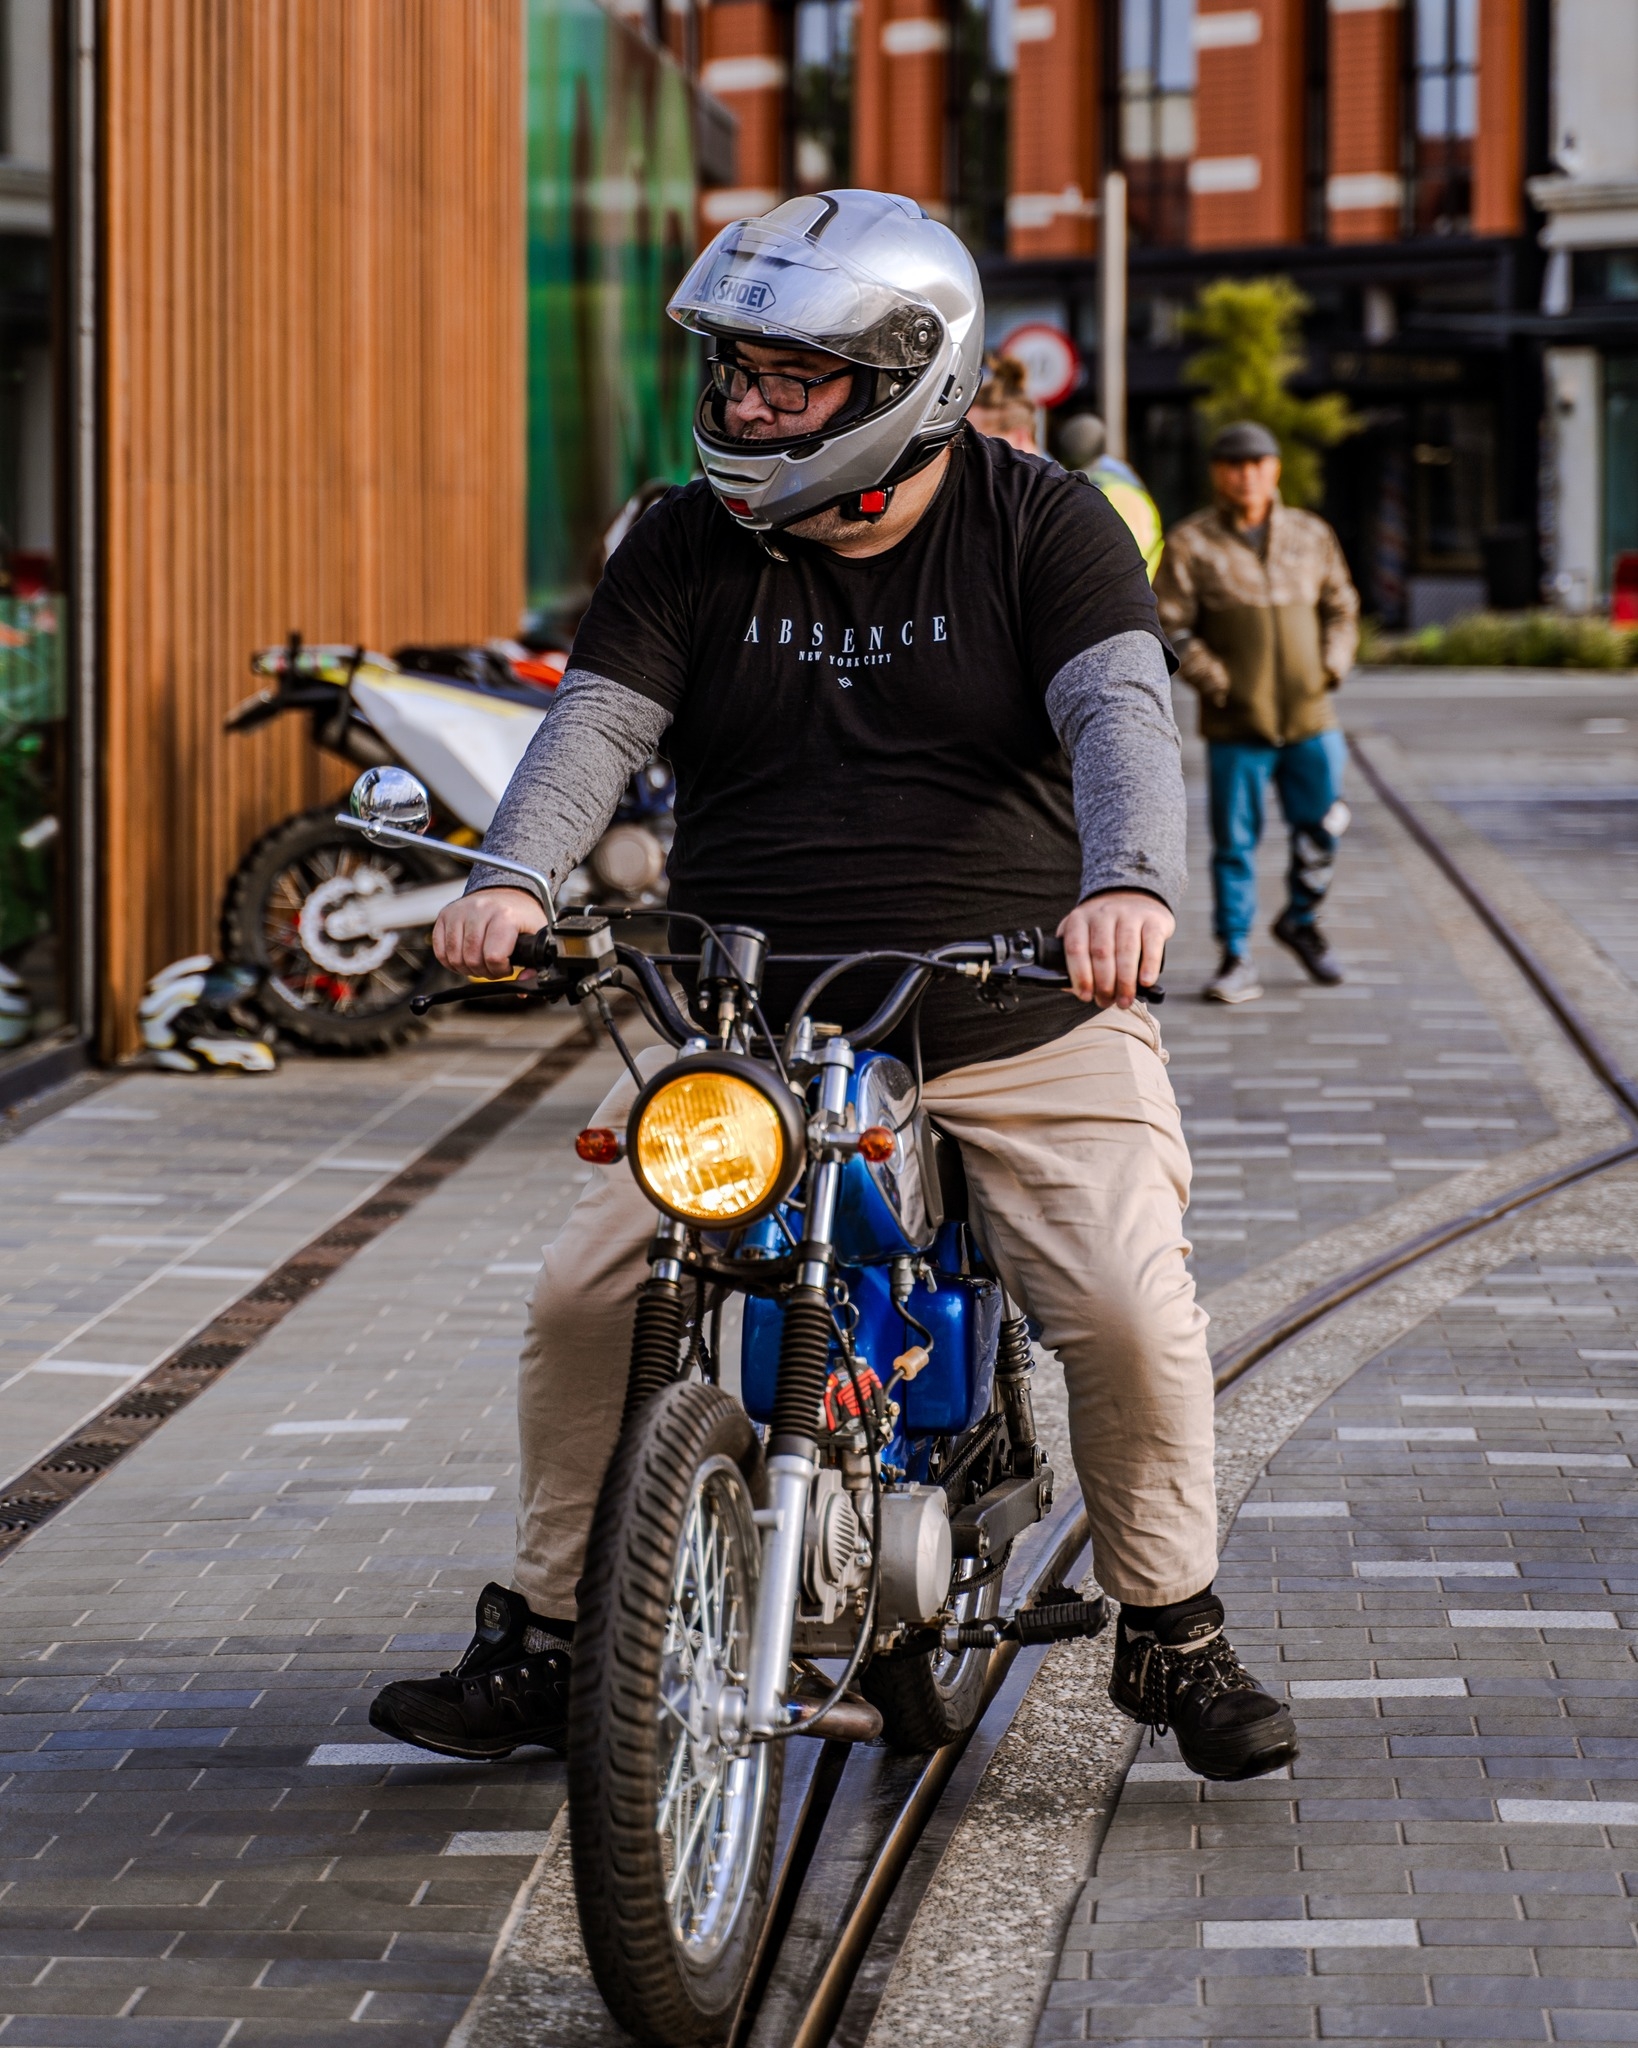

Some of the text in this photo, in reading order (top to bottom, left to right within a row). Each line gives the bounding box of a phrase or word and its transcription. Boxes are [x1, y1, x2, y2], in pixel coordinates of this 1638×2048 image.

[717, 280, 767, 308] SHOEI
[744, 616, 947, 653] ABSENCE
[798, 651, 891, 667] NEW YORK CITY
